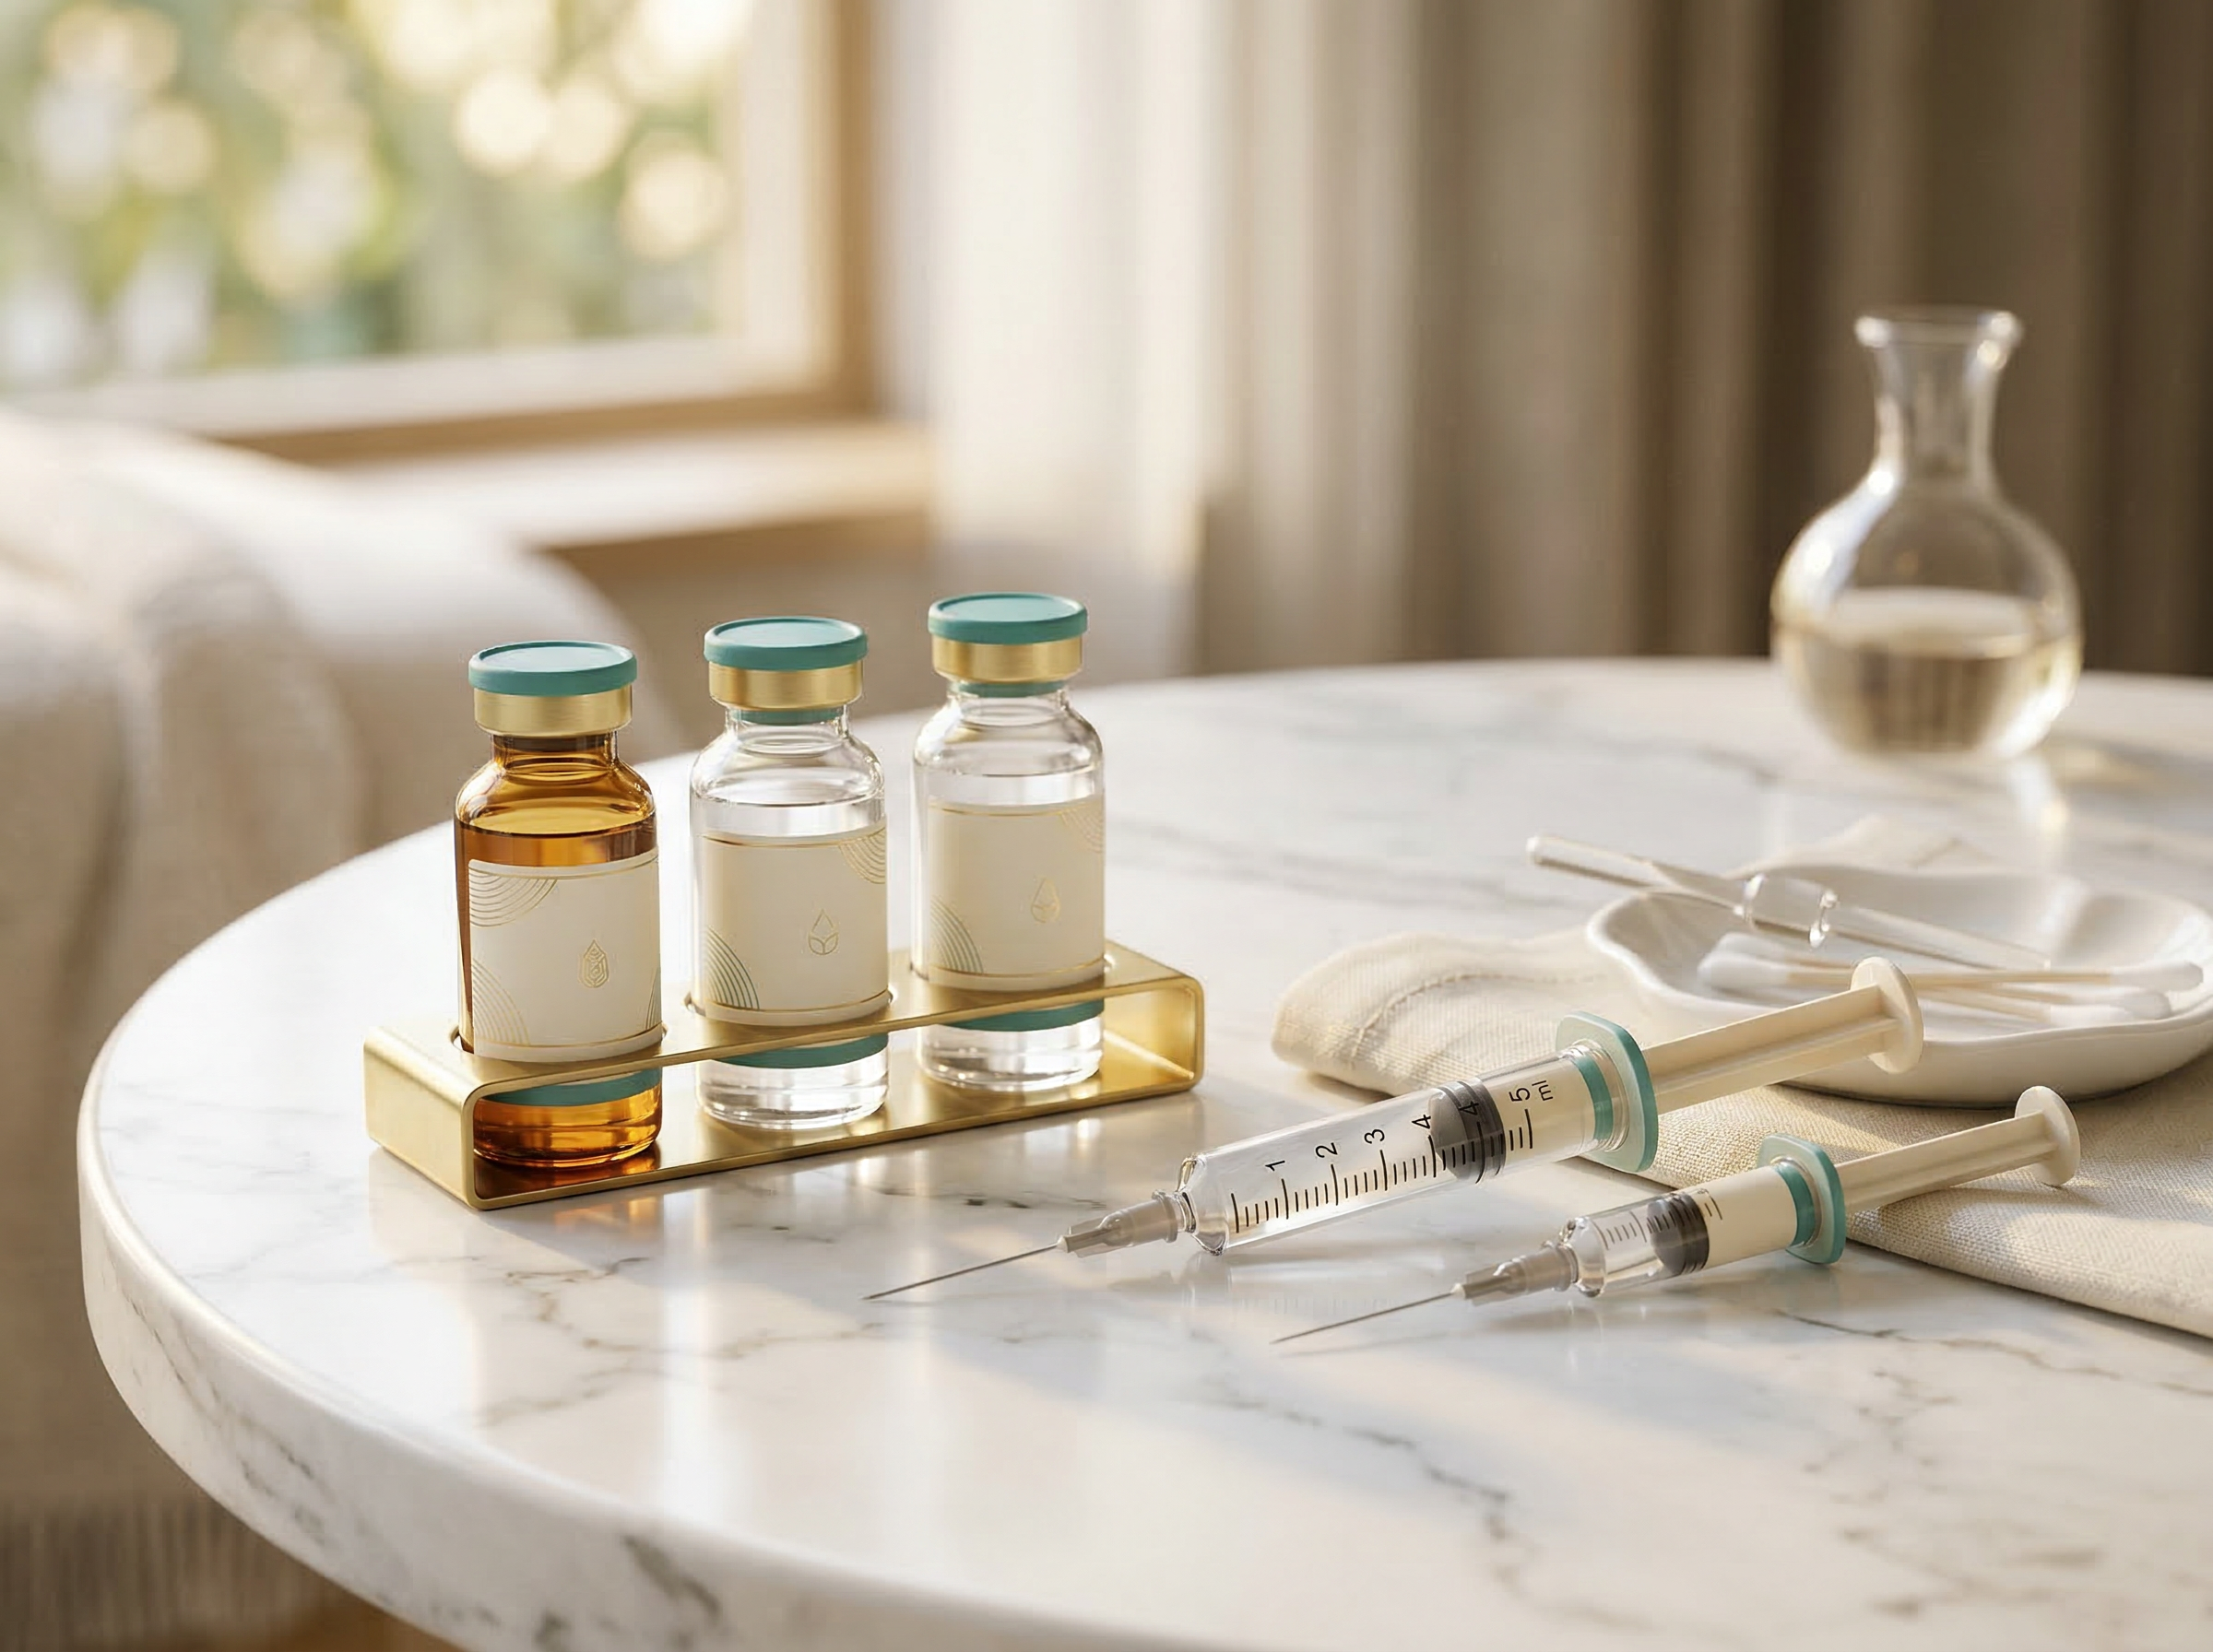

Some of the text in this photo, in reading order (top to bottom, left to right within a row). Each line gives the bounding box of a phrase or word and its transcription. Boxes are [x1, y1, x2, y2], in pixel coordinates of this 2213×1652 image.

[1509, 1087, 1531, 1103] 5
[1532, 1080, 1554, 1102] ml
[1458, 1101, 1480, 1116] 4
[1411, 1114, 1432, 1129] 4
[1364, 1128, 1385, 1145] 3
[1315, 1142, 1338, 1158] 2
[1264, 1160, 1285, 1172] 1
